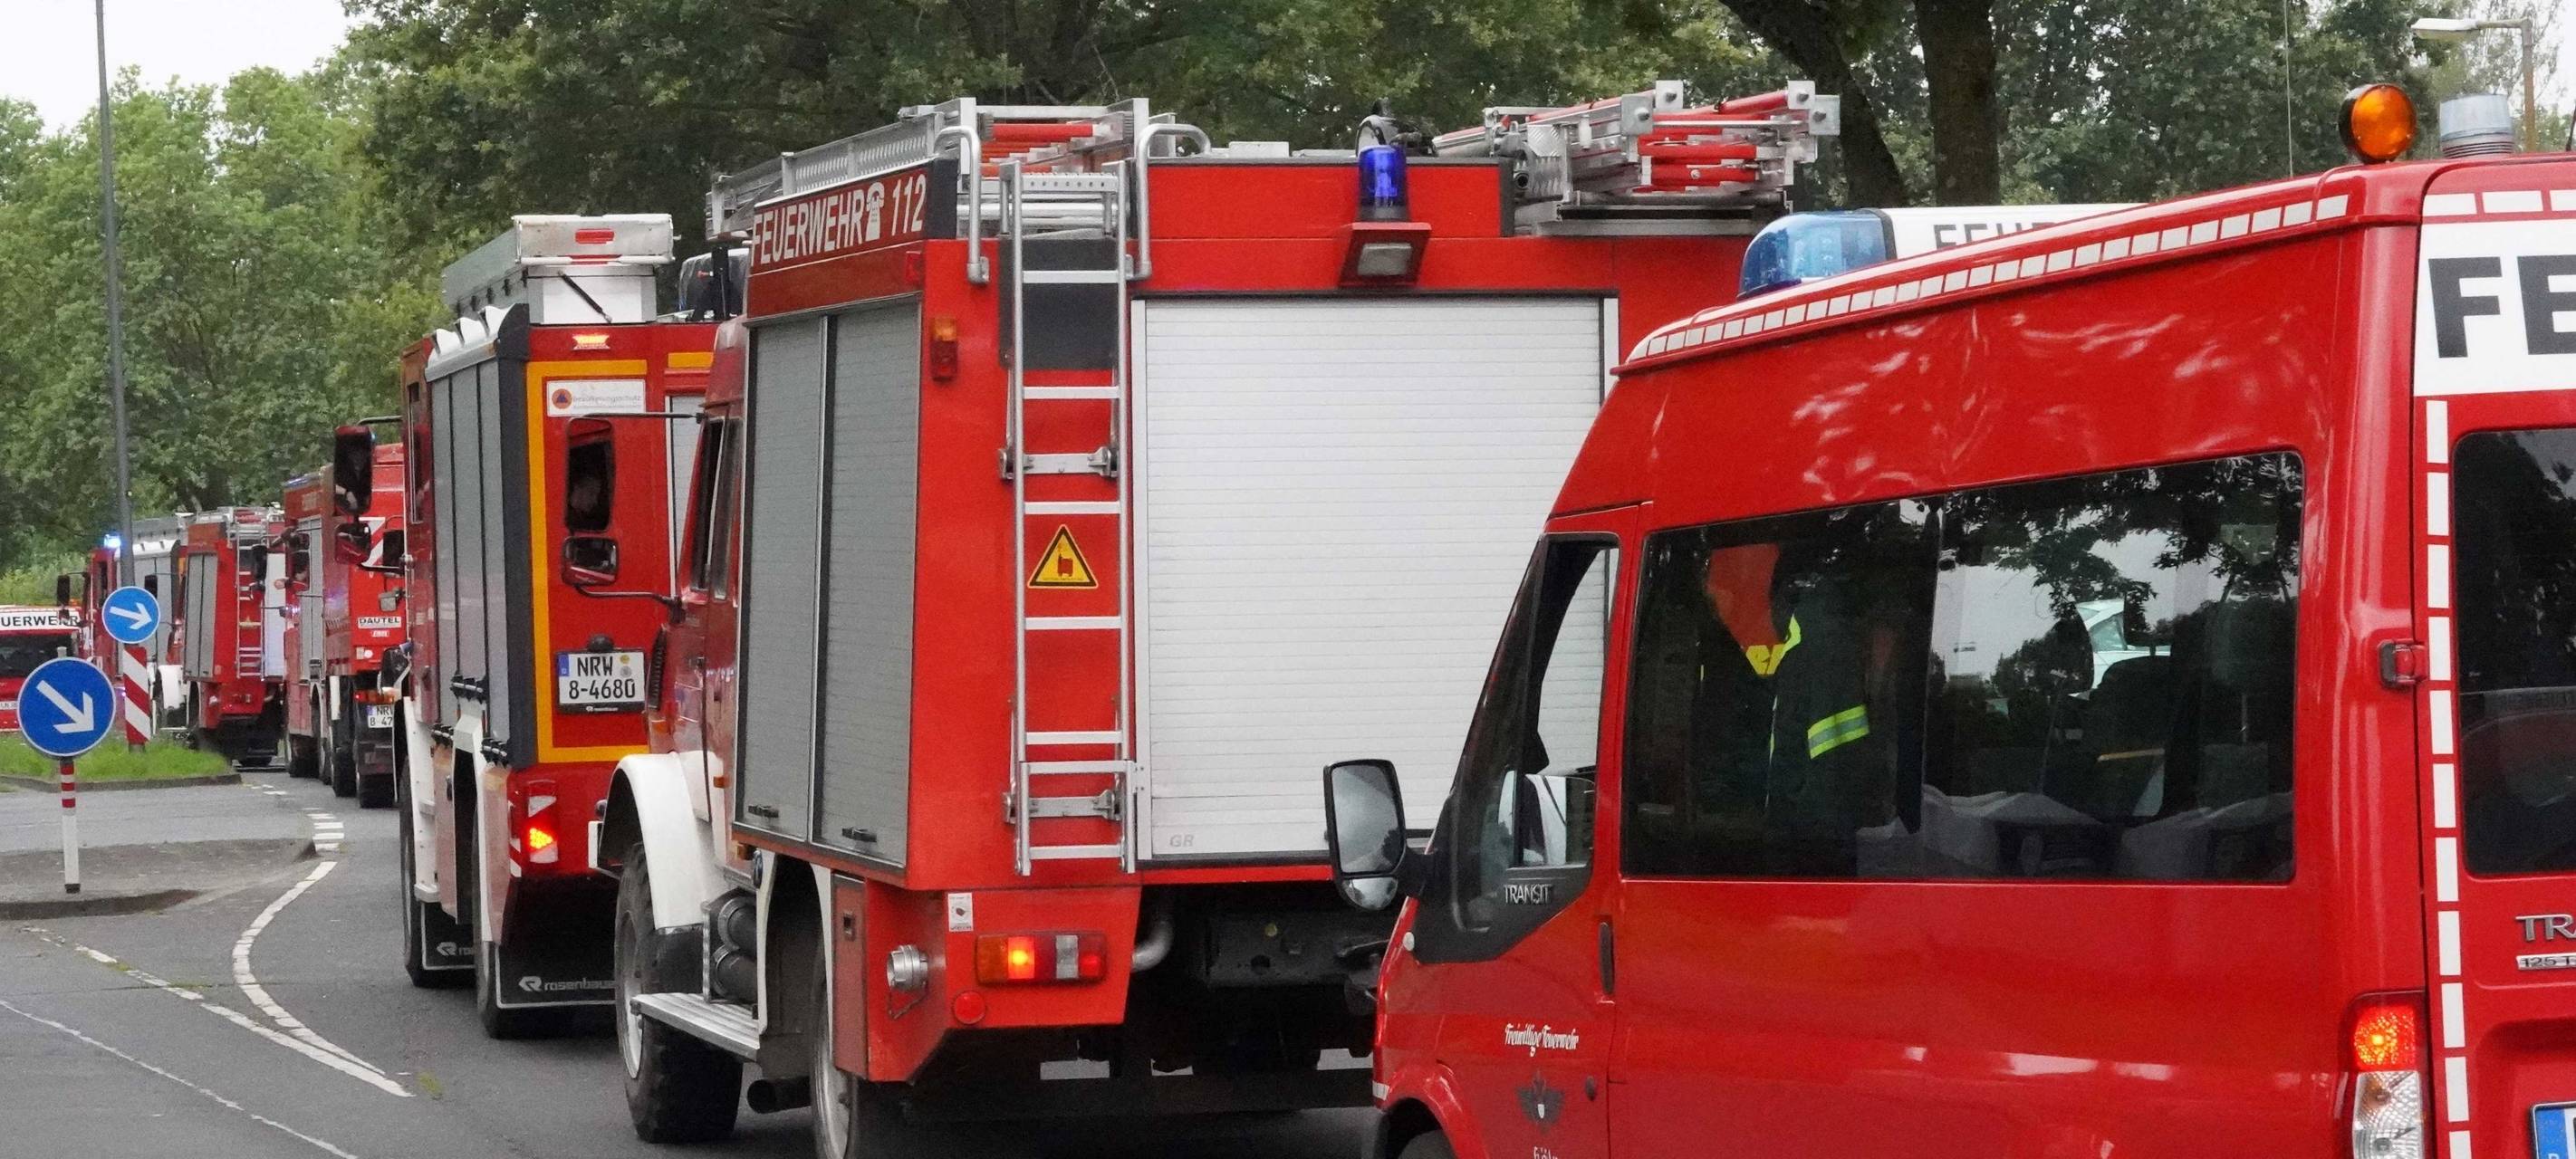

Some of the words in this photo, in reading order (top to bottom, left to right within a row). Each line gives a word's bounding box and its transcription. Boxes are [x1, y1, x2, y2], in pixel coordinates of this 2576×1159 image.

[750, 189, 865, 267] FEUERWEHR
[891, 174, 926, 236] 112
[2428, 254, 2576, 359] FE
[359, 617, 400, 625] DAUTEL
[577, 656, 613, 676] NRW
[569, 678, 636, 700] 8-4680
[1169, 834, 1195, 848] GR
[1504, 884, 1552, 904] TRANSIT
[2515, 914, 2576, 942] TR
[544, 977, 616, 991] rosenbaue
